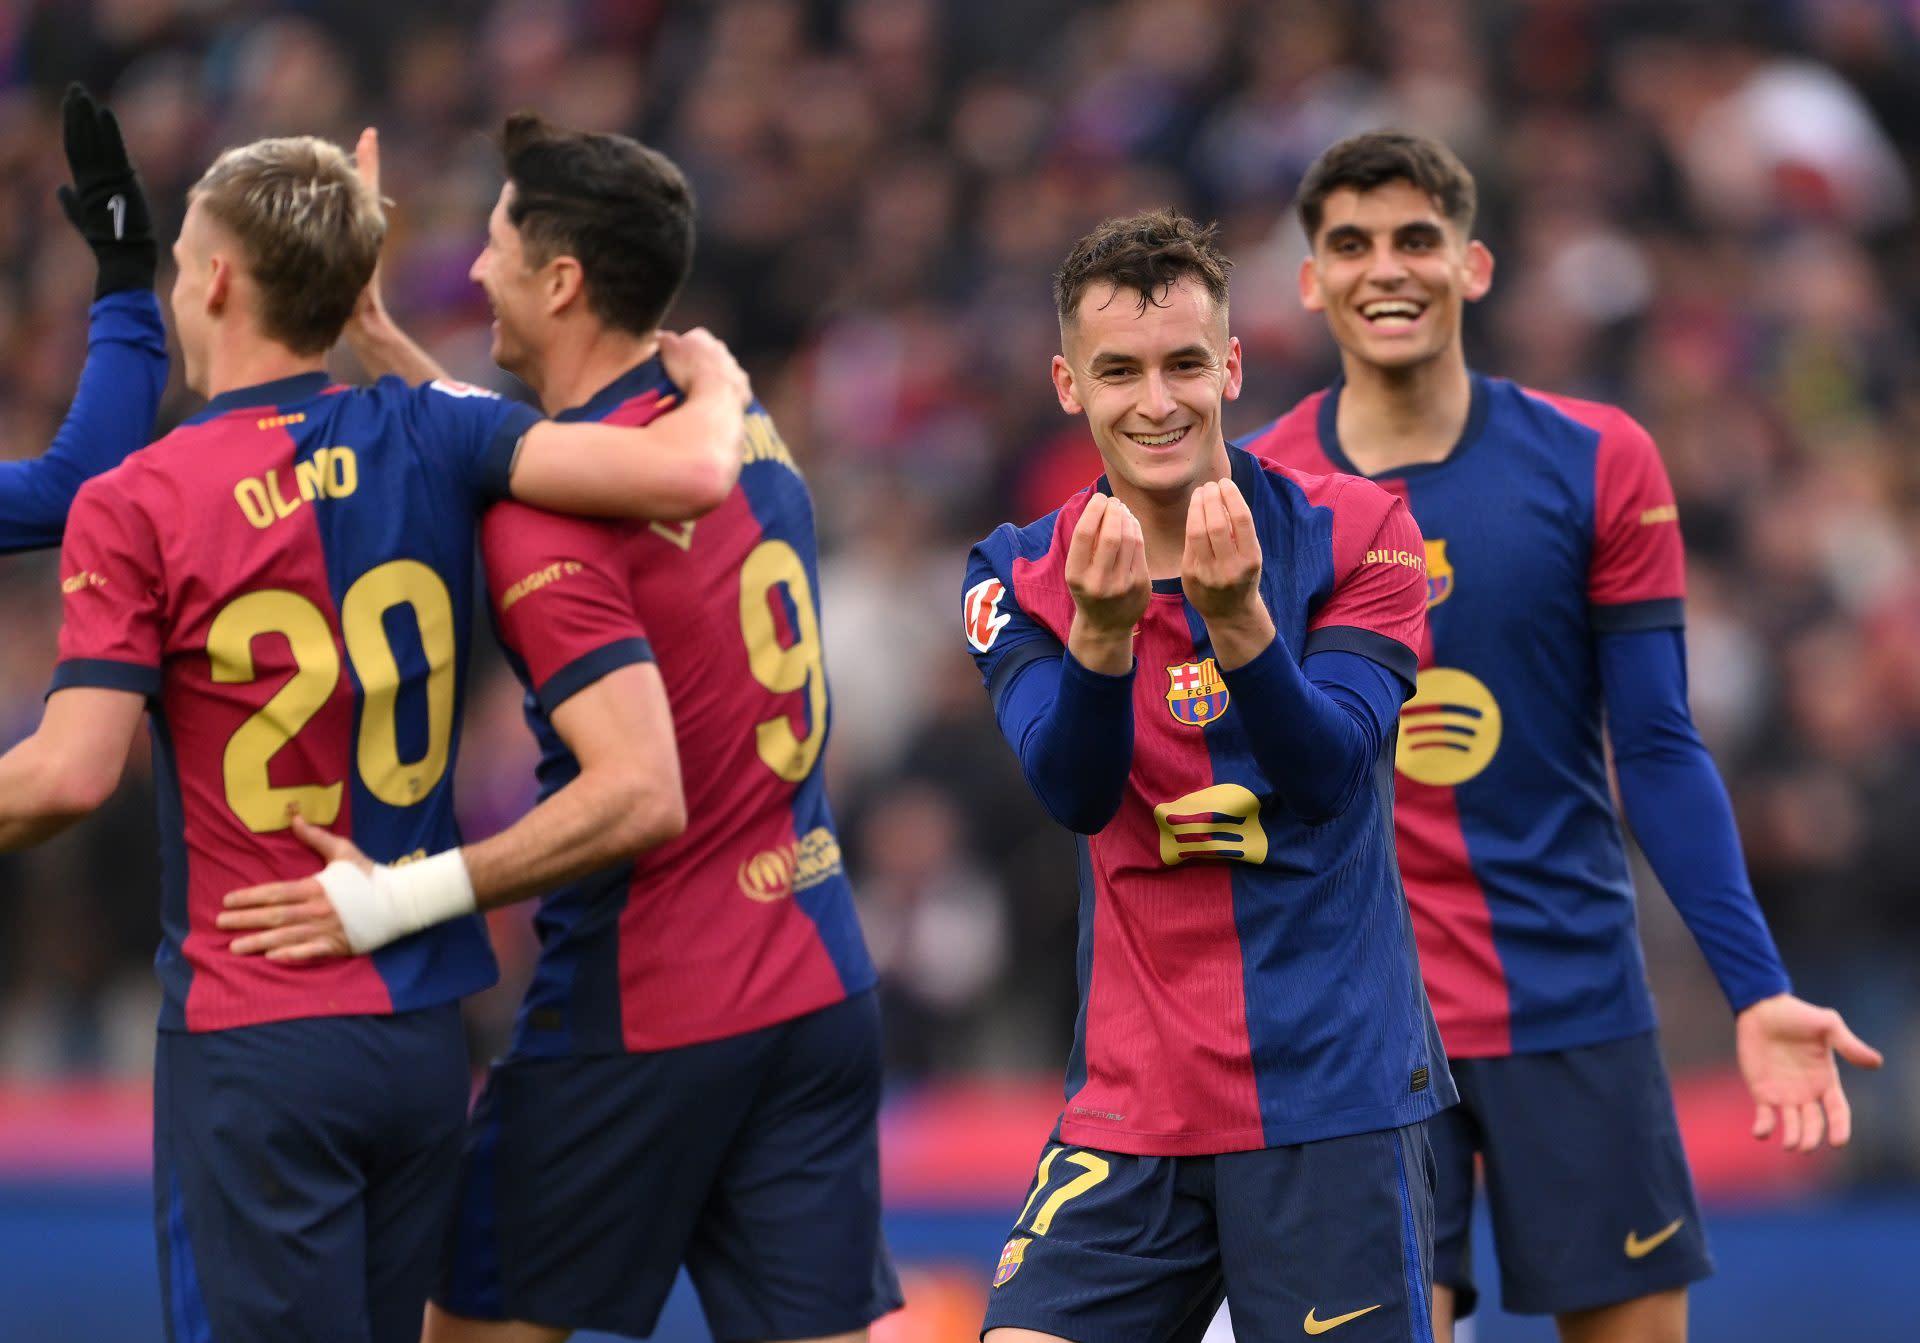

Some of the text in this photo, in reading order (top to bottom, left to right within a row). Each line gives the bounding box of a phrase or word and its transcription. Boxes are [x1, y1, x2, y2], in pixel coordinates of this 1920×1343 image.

[1362, 549, 1422, 572] BILIGHT
[206, 559, 456, 833] 20
[739, 539, 828, 782] 9
[1012, 1147, 1109, 1236] 17
